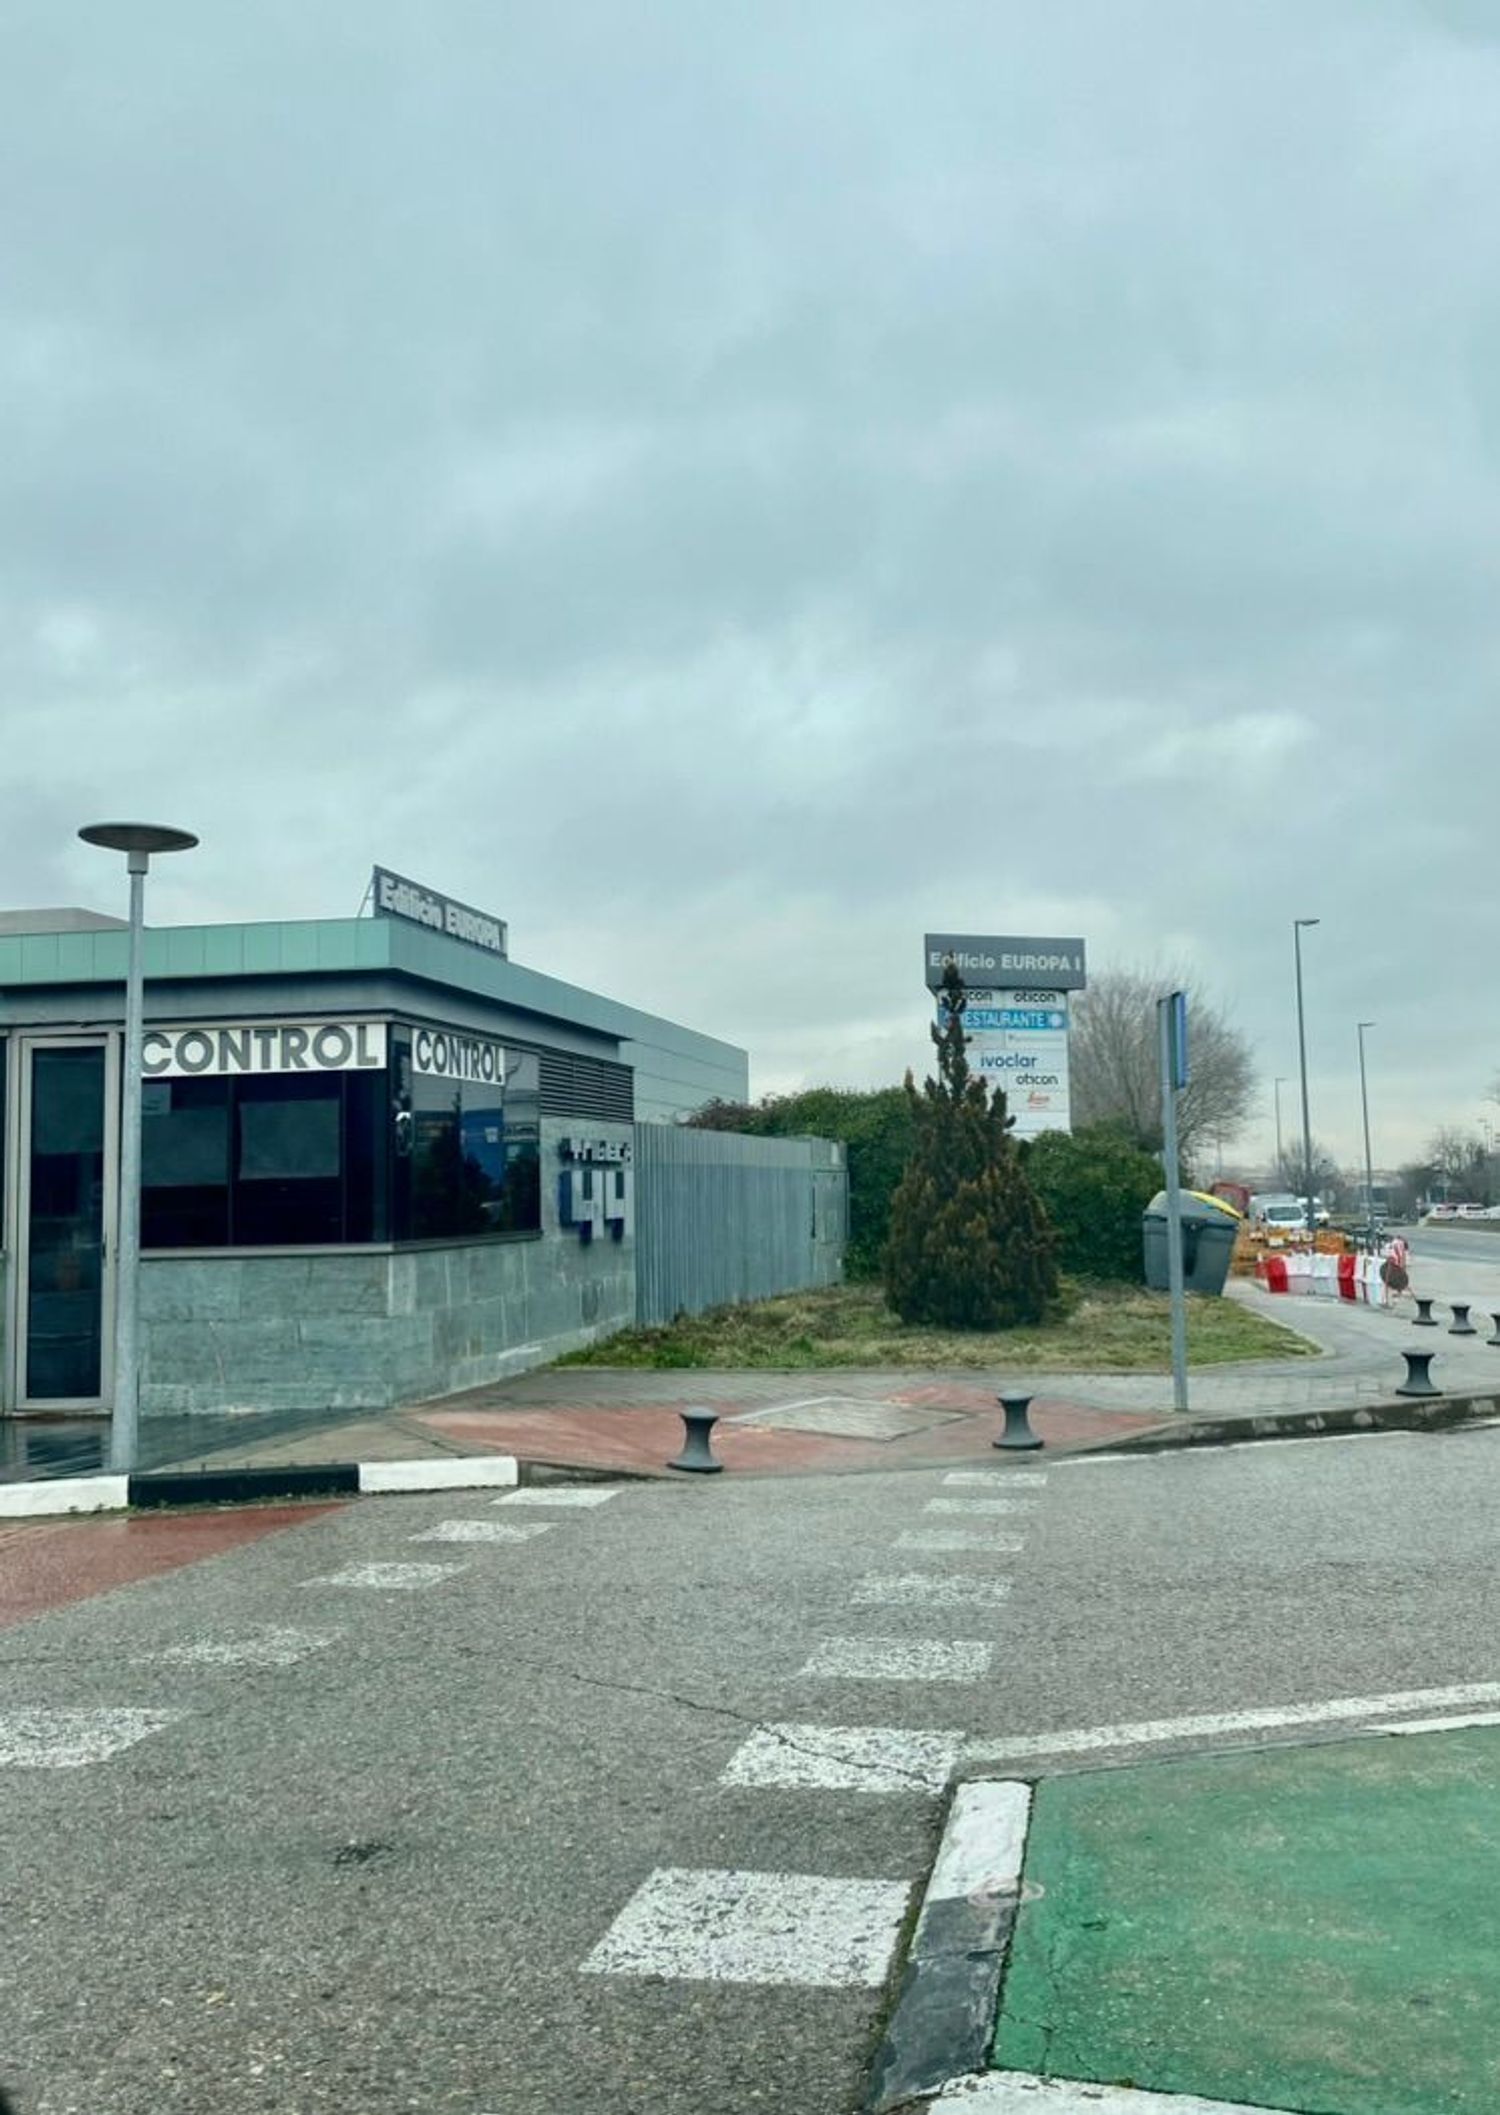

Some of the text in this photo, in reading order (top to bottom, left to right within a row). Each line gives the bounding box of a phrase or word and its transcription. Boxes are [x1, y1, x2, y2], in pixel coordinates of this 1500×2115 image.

[1001, 953, 1070, 970] EUROPA
[1075, 955, 1080, 971] I
[1013, 990, 1057, 1003] oticon
[964, 1011, 1046, 1027] ESTAURANTE
[141, 1025, 378, 1075] CONTROL
[415, 1030, 505, 1083] CONTROL
[980, 1052, 1038, 1068] ivoclar
[1015, 1074, 1059, 1085] oticon
